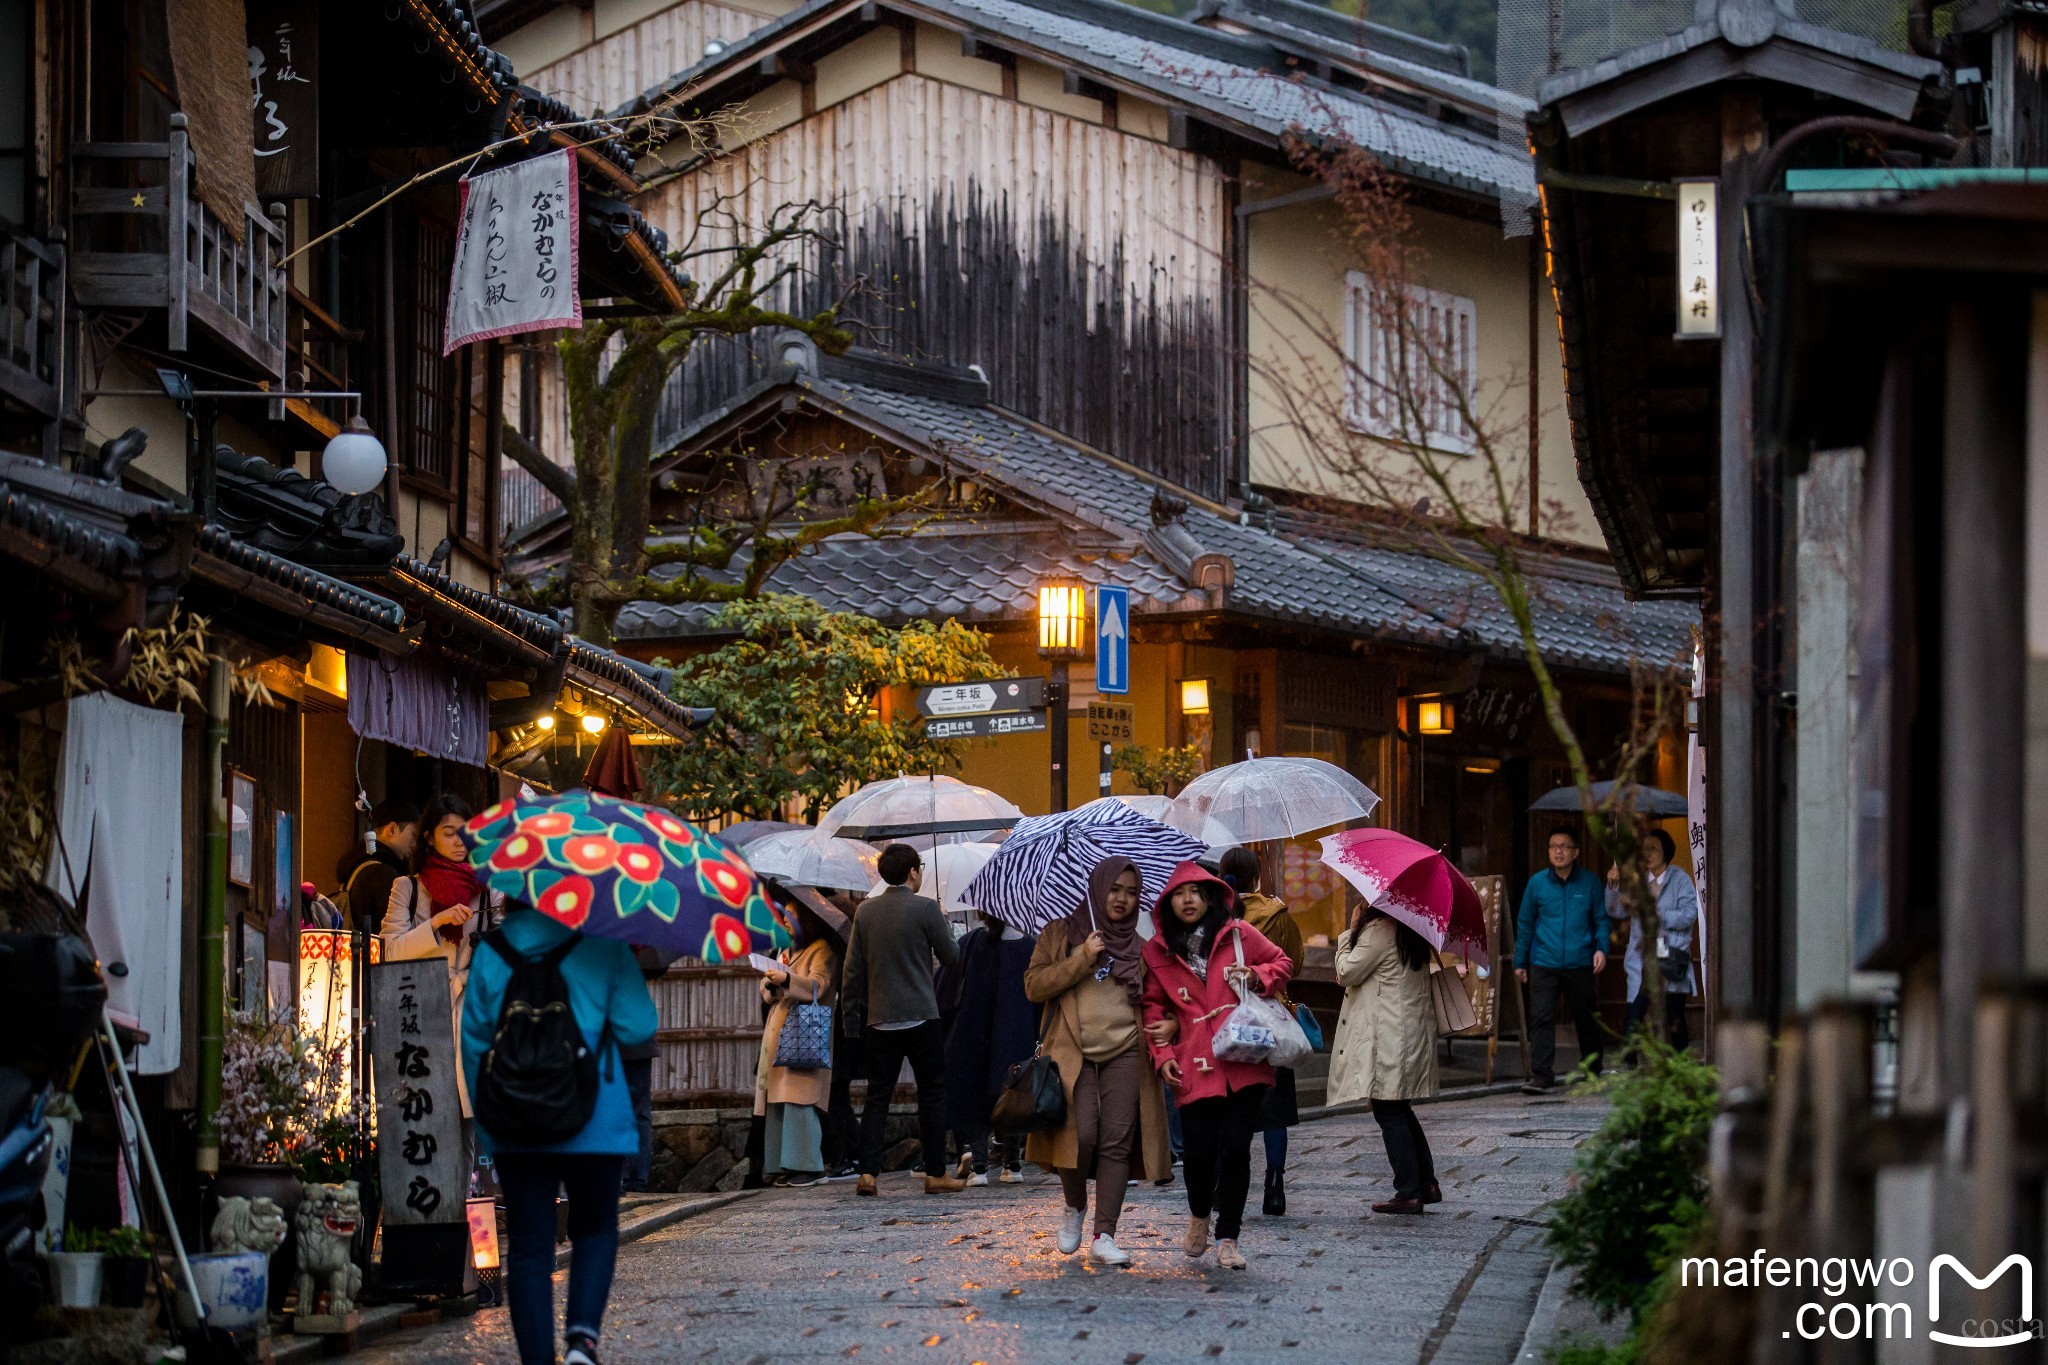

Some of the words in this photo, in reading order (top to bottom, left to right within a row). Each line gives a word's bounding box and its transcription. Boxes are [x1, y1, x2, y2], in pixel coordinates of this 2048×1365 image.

[554, 180, 566, 220] 二年坂
[531, 190, 557, 299] なかむらの
[942, 687, 981, 701] 二年坂
[949, 721, 973, 731] 高台寺
[1011, 716, 1035, 725] 清水寺
[1091, 722, 1131, 738] ここから
[398, 975, 422, 1036] 二年坂
[395, 1041, 441, 1215] なかむら
